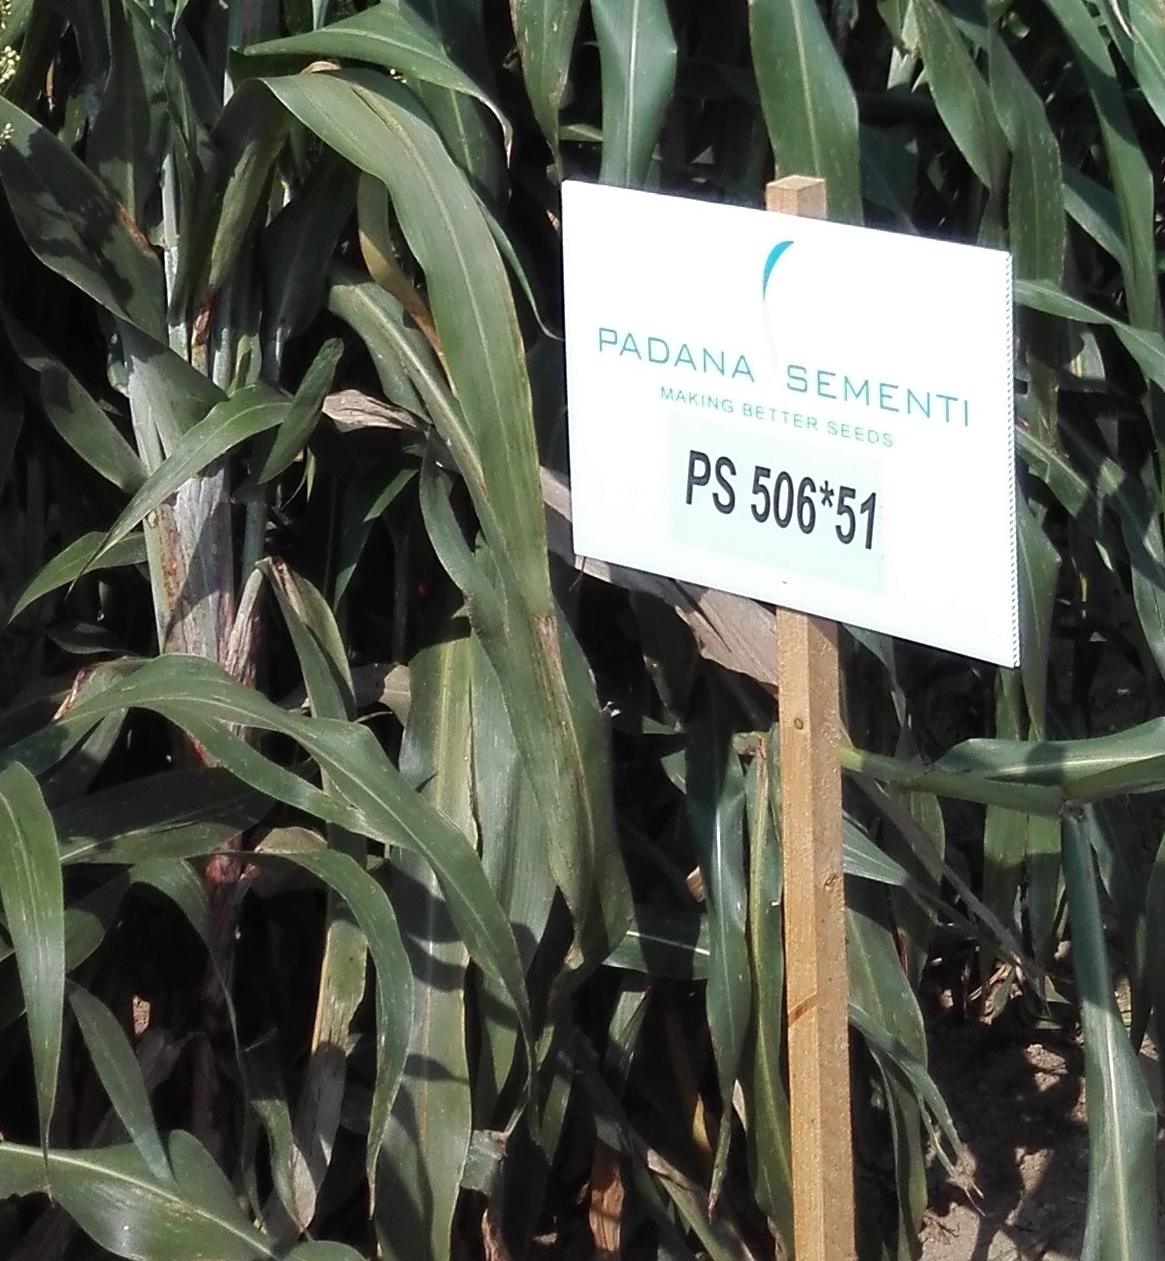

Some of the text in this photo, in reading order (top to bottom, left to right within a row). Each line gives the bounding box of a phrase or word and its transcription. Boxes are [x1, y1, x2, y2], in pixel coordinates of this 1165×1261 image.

[598, 327, 969, 427] PADANA SEMENTI
[660, 386, 894, 448] MAKING BETTER SEEDS
[685, 449, 738, 515] PS
